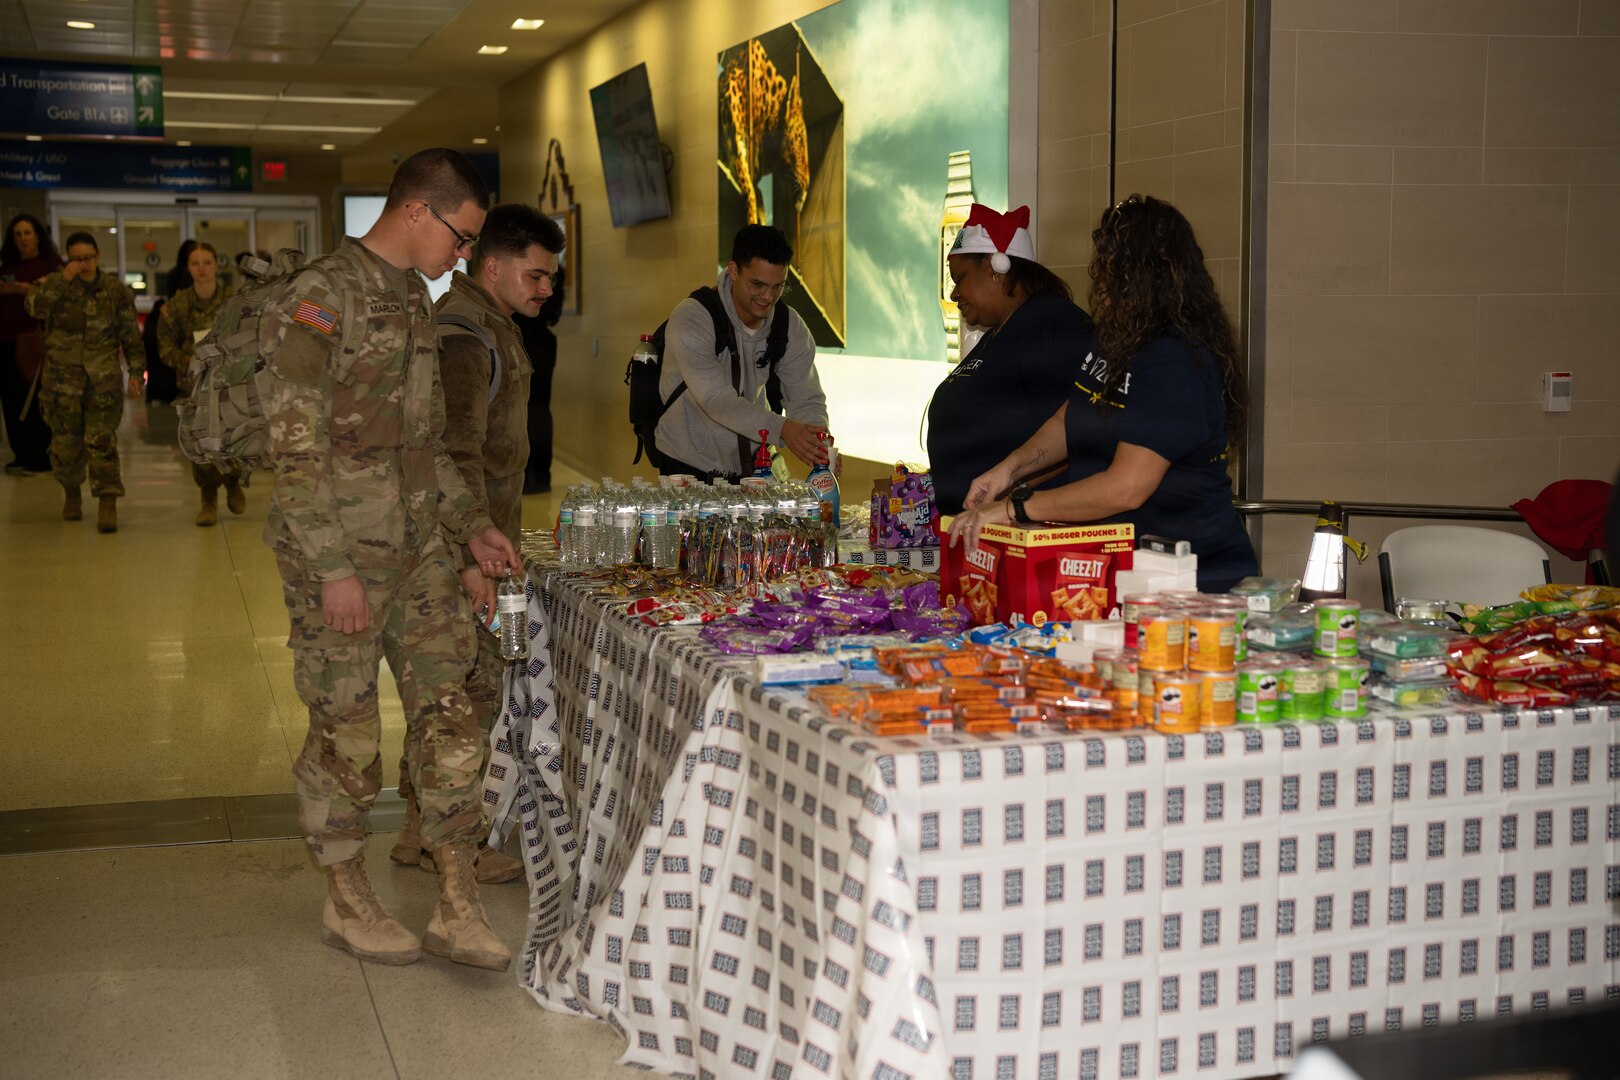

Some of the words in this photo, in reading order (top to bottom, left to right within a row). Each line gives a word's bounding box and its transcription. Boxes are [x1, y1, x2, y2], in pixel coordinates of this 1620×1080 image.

[11, 74, 106, 92] Transportation
[47, 105, 80, 121] Gate
[159, 174, 217, 187] Transportation
[812, 478, 834, 487] Coffee
[1033, 533, 1050, 541] 50%
[591, 679, 600, 694] USO
[704, 748, 718, 762] US
[606, 792, 616, 815] USO
[597, 840, 605, 859] USO
[667, 858, 683, 870] USO
[670, 895, 688, 908] USO
[726, 918, 743, 933] USO
[717, 955, 734, 971] USO
[710, 993, 727, 1010] USO
